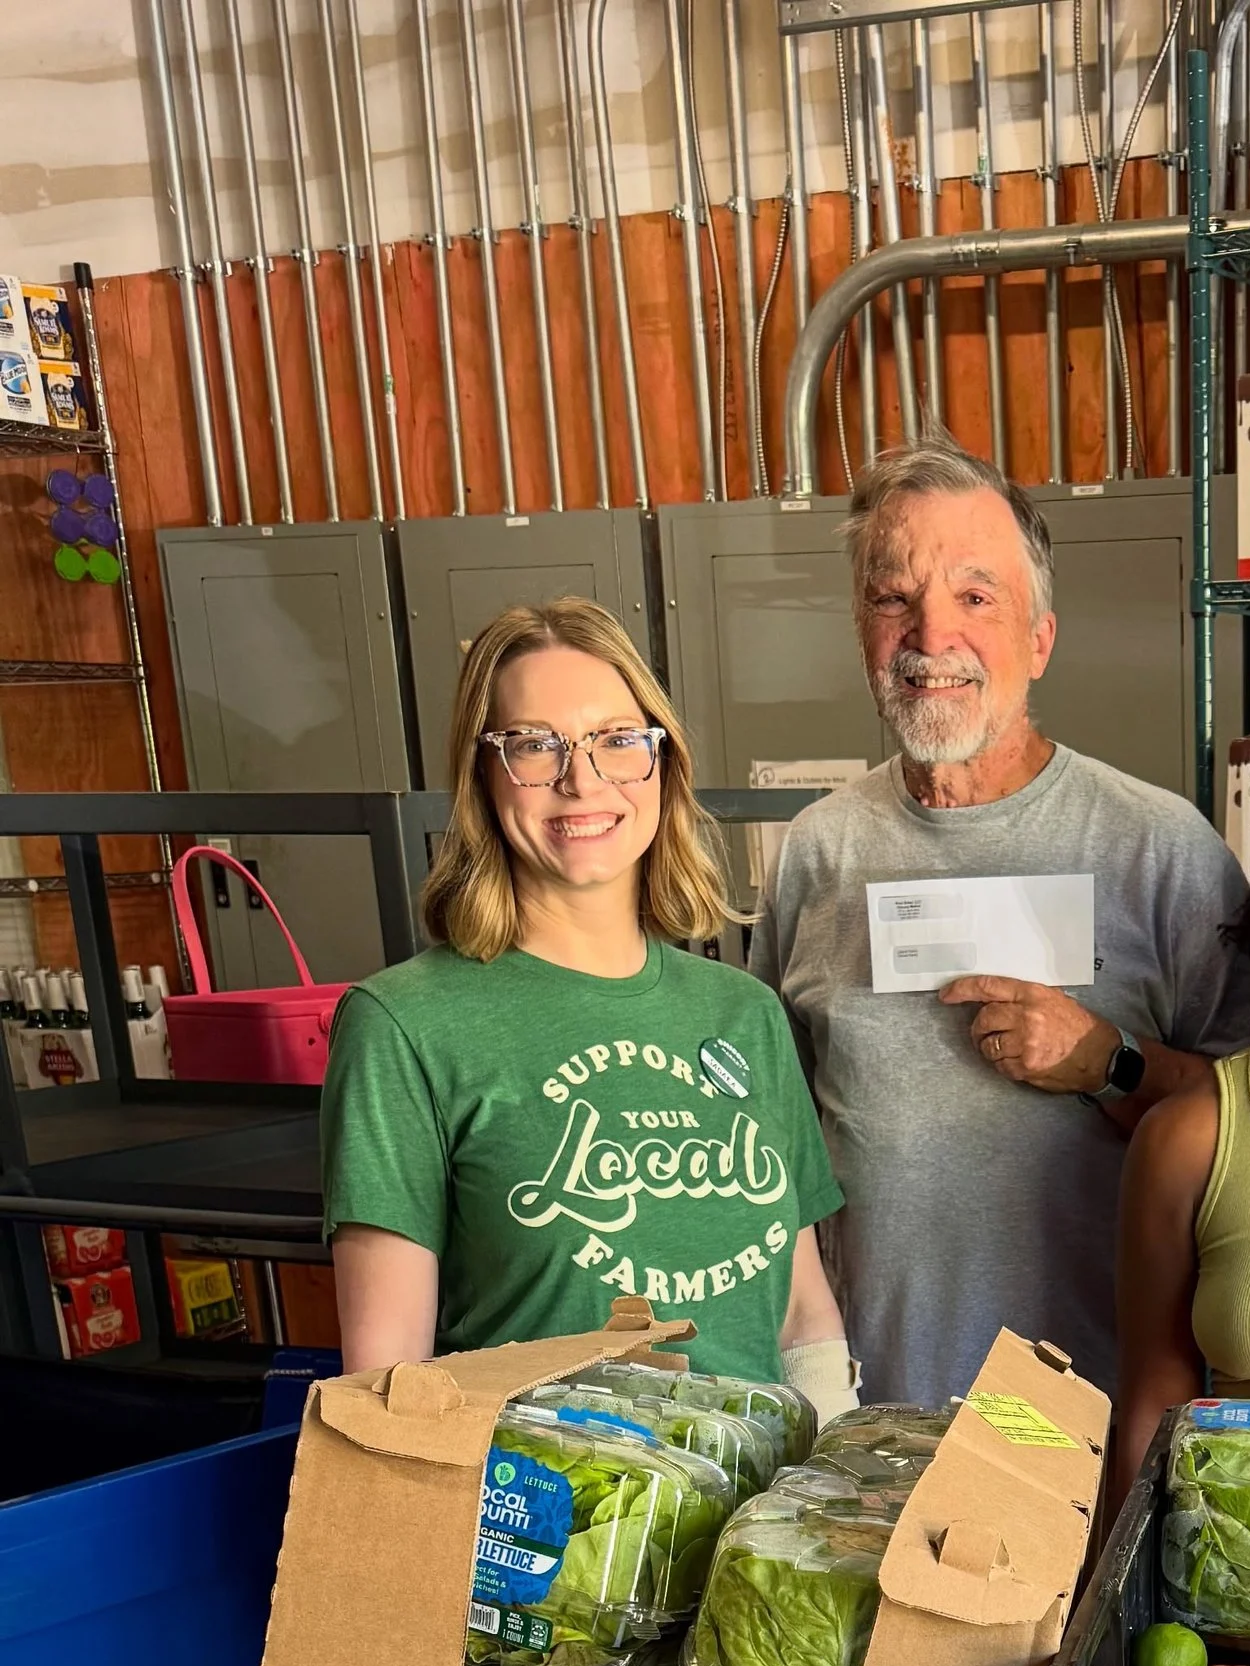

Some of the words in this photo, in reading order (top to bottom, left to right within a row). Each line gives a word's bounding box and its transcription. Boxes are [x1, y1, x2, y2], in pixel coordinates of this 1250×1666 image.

[620, 1110, 701, 1129] YOUR
[507, 1099, 788, 1233] Local
[571, 1220, 788, 1305] FARMERS
[524, 1475, 558, 1493] LETTUCE
[481, 1529, 515, 1544] GANIC
[484, 1539, 537, 1571] LETTUCE
[487, 1567, 500, 1577] for
